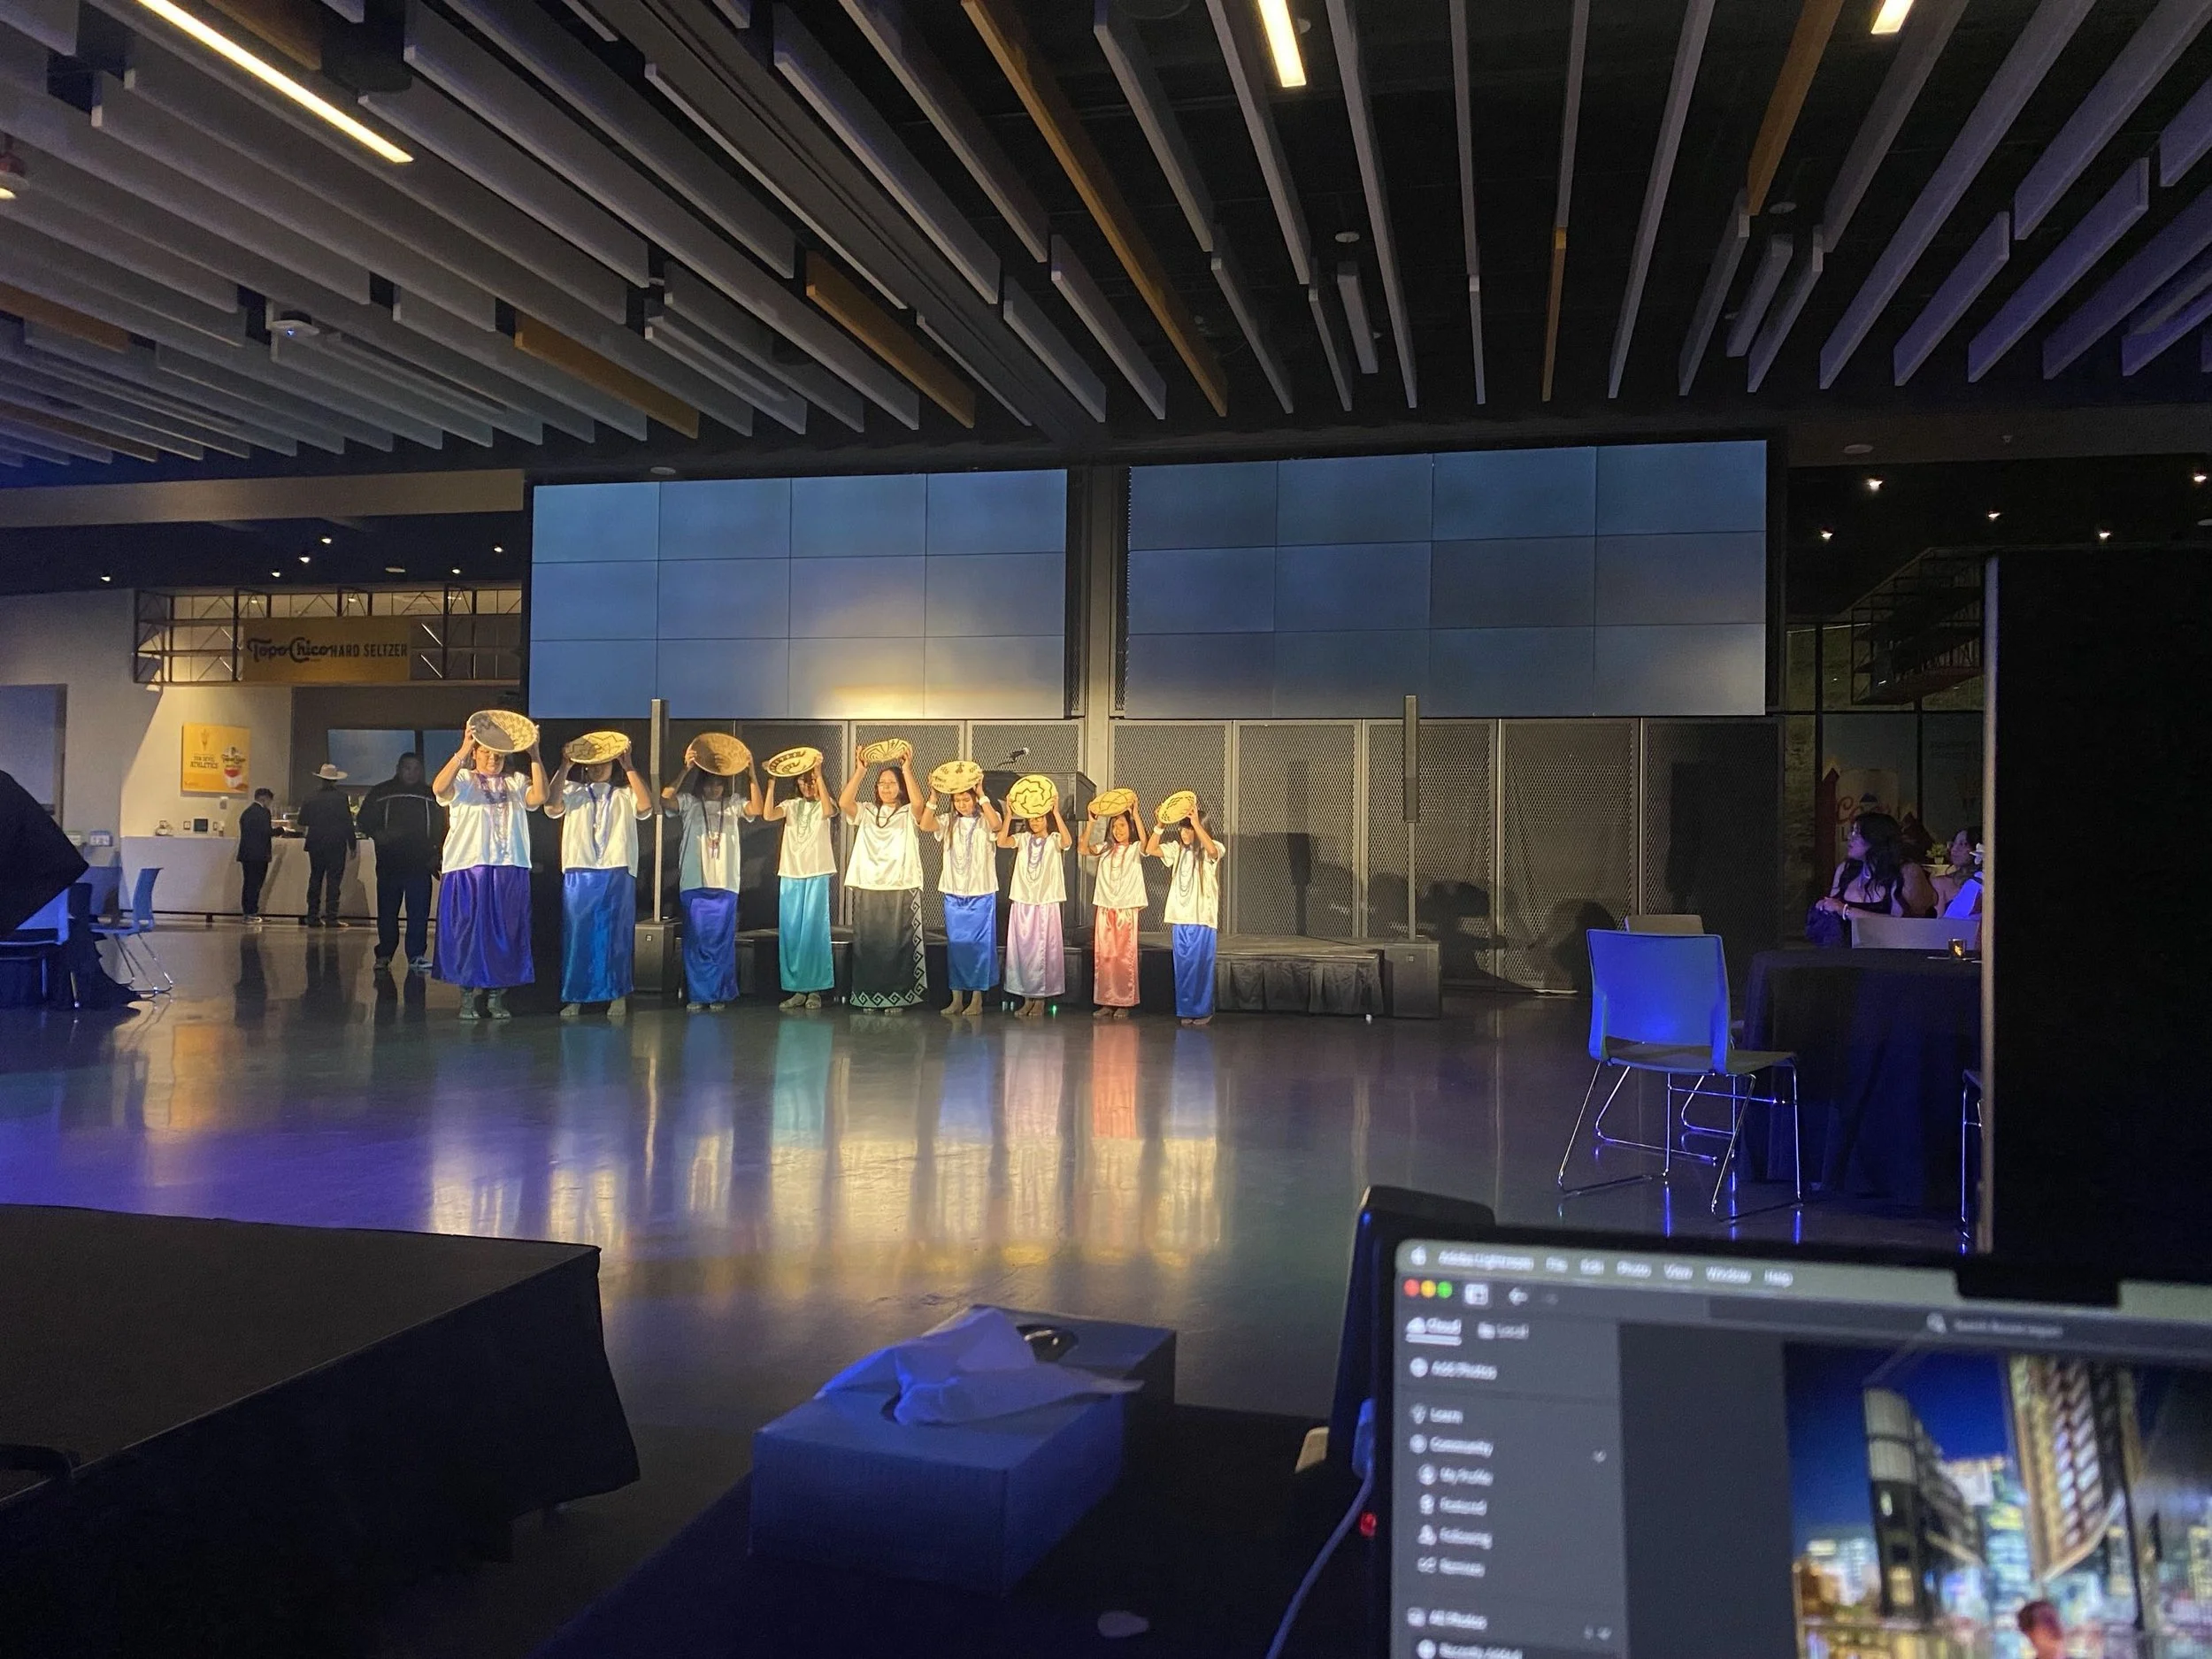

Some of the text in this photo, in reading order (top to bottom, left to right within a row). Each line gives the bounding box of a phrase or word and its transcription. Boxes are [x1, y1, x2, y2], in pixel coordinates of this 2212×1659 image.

[248, 636, 408, 663] Topo Chico HARD SELTZER
